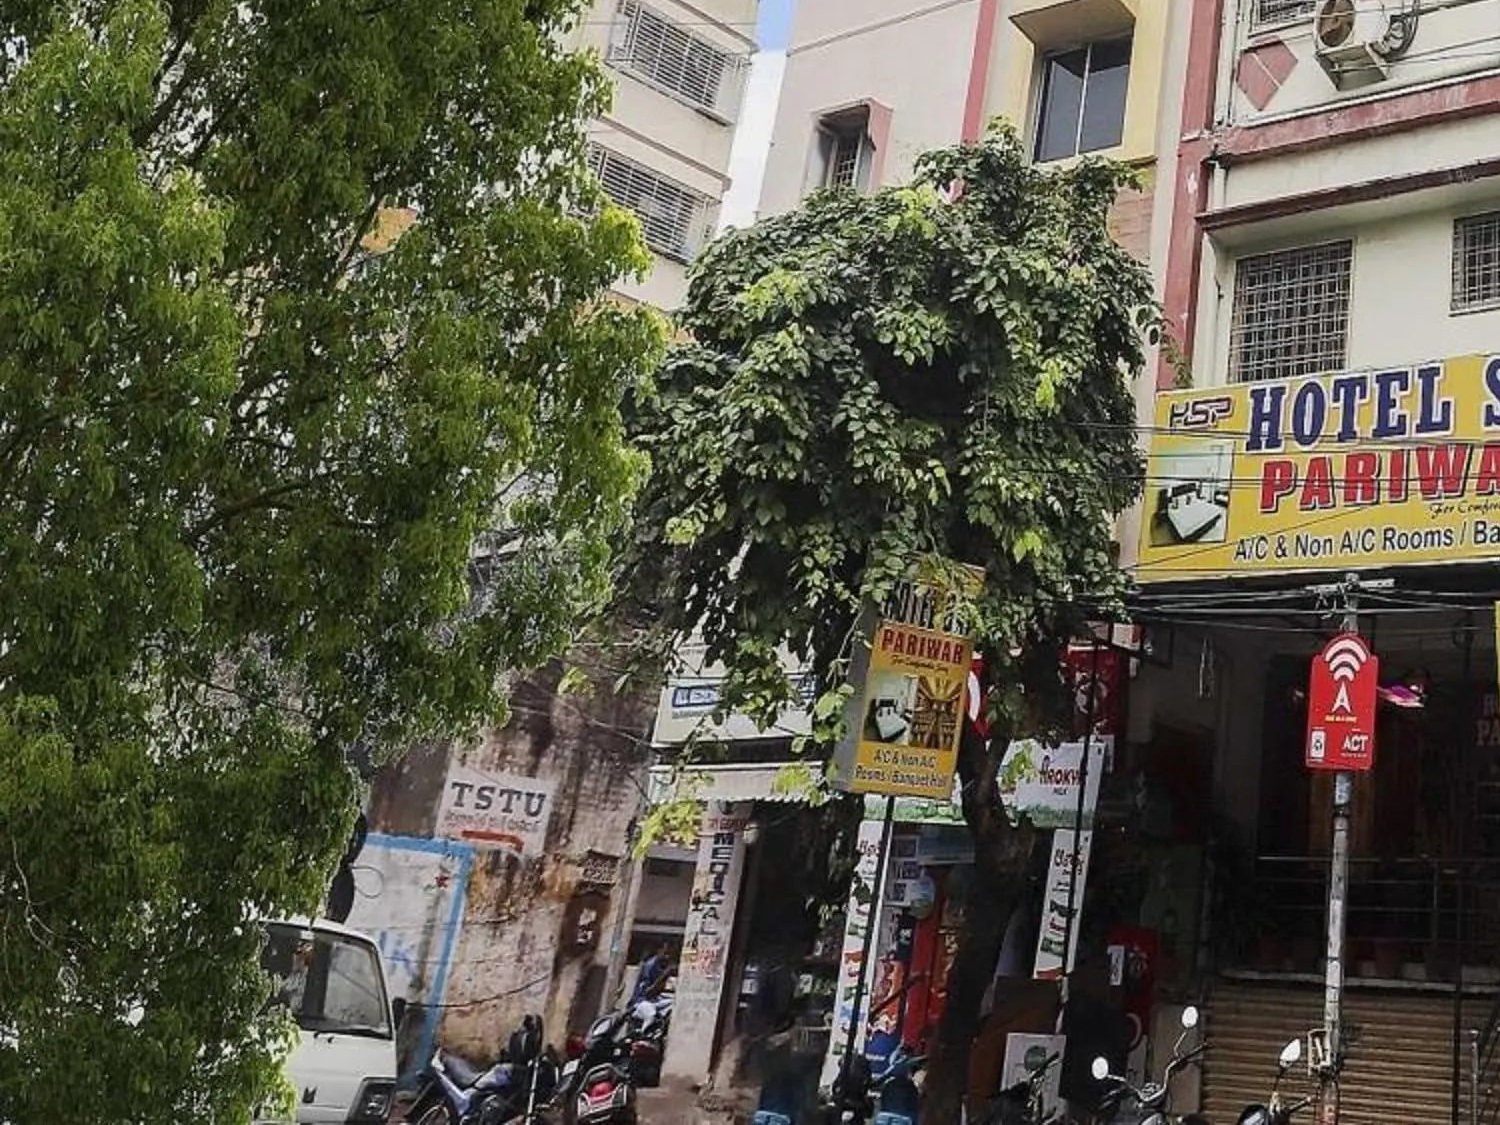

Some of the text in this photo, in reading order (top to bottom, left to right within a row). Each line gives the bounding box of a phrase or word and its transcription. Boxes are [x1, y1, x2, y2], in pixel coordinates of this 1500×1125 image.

[1246, 366, 1454, 453] HOTEL
[1234, 536, 1268, 561] A/C
[1274, 534, 1288, 557] &
[1295, 531, 1334, 556] Non
[1339, 528, 1376, 554] A/C
[1383, 525, 1453, 550] Rooms
[881, 629, 964, 664] PARIWAR
[1342, 734, 1369, 752] ACT
[452, 781, 546, 817] TSTU
